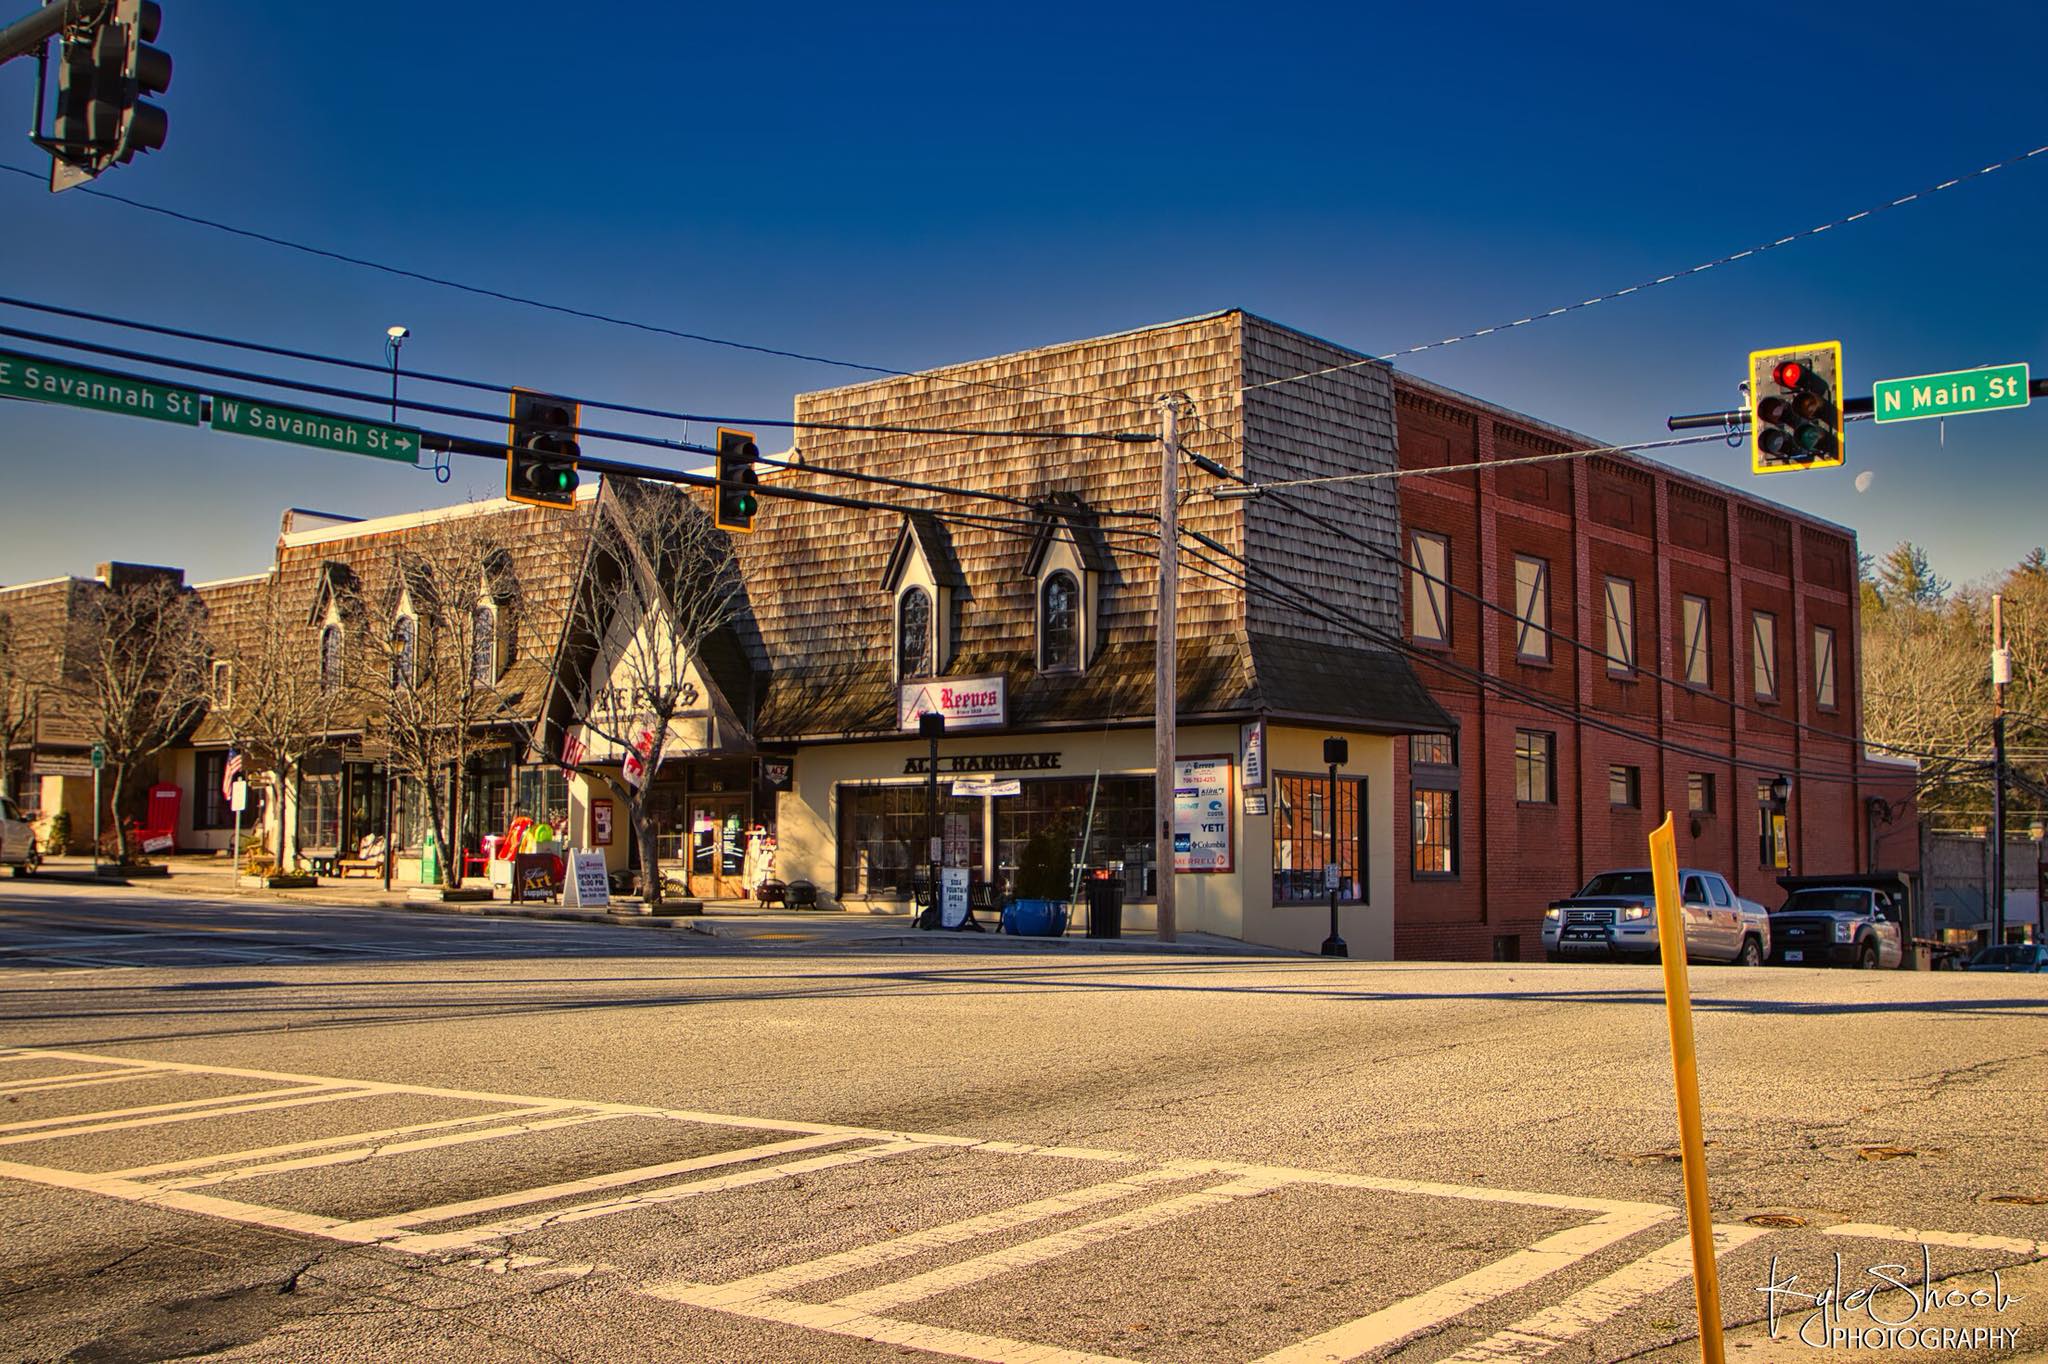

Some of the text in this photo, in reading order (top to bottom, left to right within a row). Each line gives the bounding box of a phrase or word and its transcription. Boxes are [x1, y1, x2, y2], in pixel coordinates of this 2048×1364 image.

[0, 363, 193, 415] E Savannah St
[1884, 375, 2018, 412] N Main St
[221, 402, 389, 450] W Savannah St
[941, 687, 998, 710] Reeves
[951, 752, 1062, 772] HARDWARE
[1201, 823, 1225, 832] YETI
[1198, 840, 1226, 849] Columbia
[525, 871, 552, 890] Art
[522, 889, 554, 898] supplies
